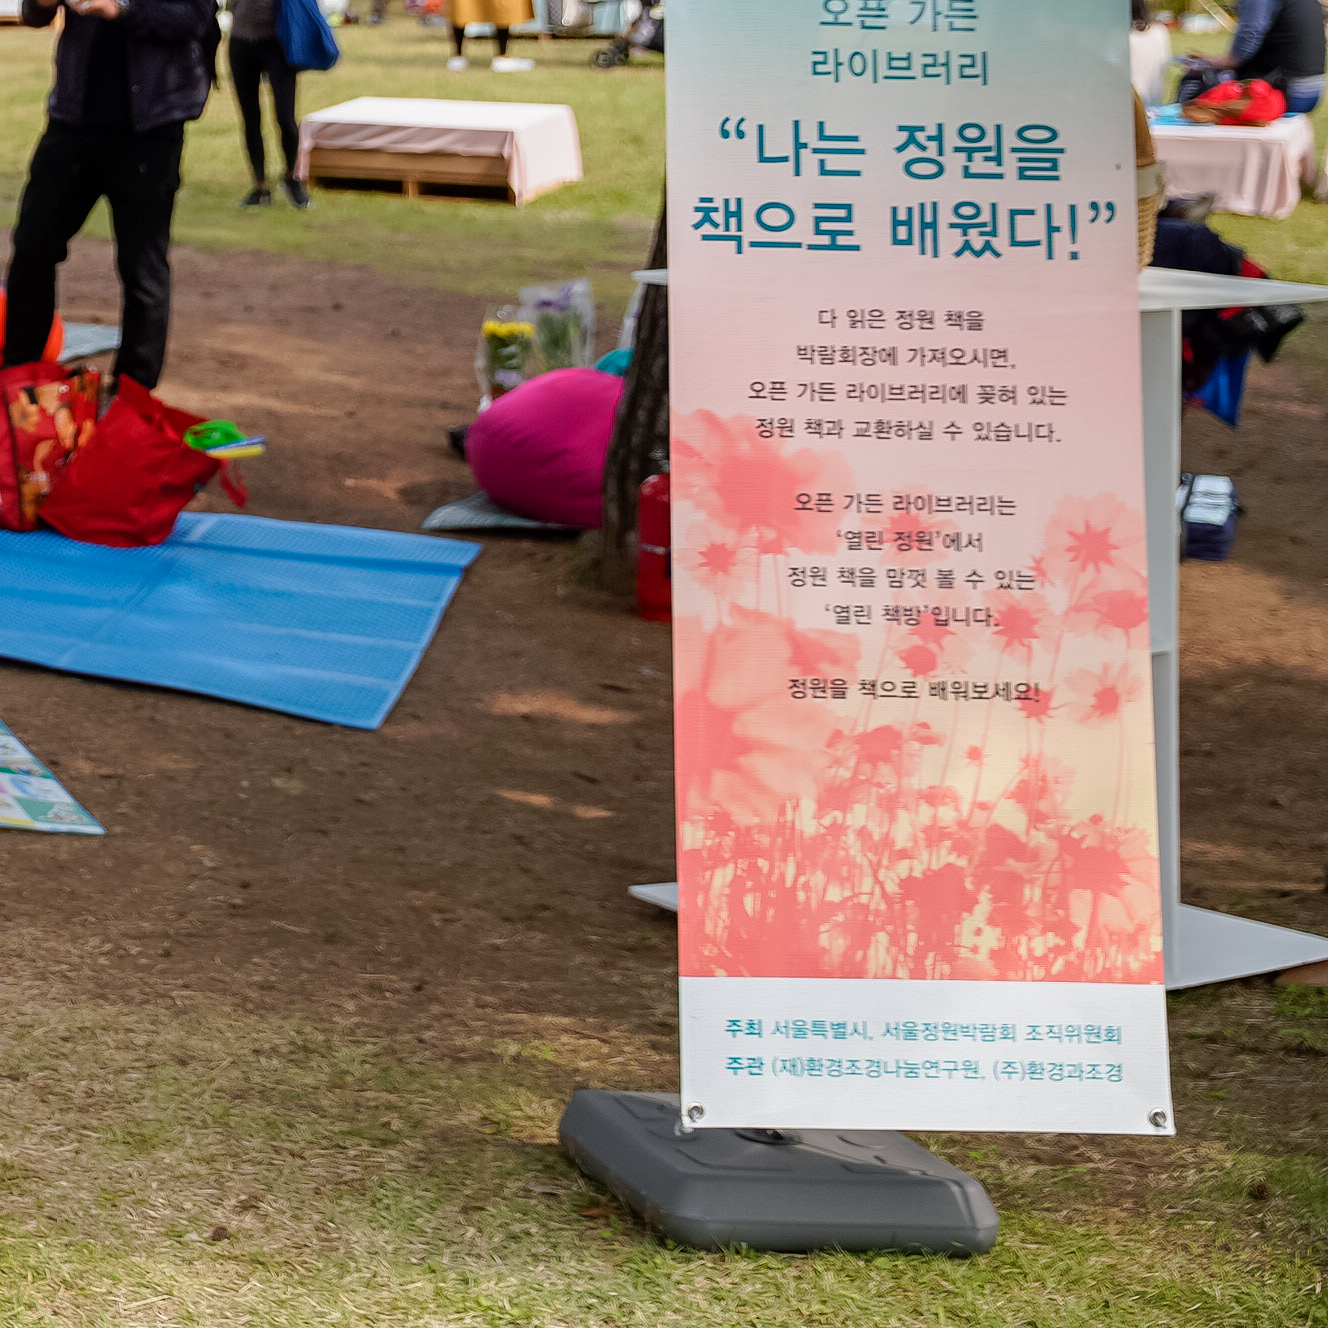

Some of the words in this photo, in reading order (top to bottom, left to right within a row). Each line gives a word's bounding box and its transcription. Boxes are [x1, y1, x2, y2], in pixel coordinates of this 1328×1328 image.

[811, 48, 989, 86] 라이브러리
[719, 116, 866, 177] “나는
[895, 122, 1066, 182] 정원을
[692, 196, 860, 254] 책으로
[890, 201, 1116, 260] 배웠다!”
[818, 309, 837, 328] 다
[847, 308, 886, 329] 읽은
[895, 309, 935, 330] 정원
[944, 309, 985, 331] 책을
[797, 345, 898, 366] 박람회장에
[907, 347, 1016, 370] 가져오시면,
[748, 381, 787, 401] 오픈
[797, 382, 837, 402] 가든
[846, 383, 969, 404] 라이브러리에
[977, 385, 1017, 405] 꽂혀
[1027, 386, 1068, 406] 있는
[755, 418, 795, 439] 정원
[804, 419, 845, 440] 책과
[852, 419, 933, 440] 교환하실
[944, 421, 962, 441] 수
[973, 421, 1062, 442] 있습니다.
[794, 493, 834, 512] 오픈
[843, 494, 883, 513] 가든
[893, 494, 1017, 516] 라이브러리는
[789, 567, 827, 587] 정원
[837, 567, 876, 587] 책을
[886, 568, 926, 588] 맘껏
[936, 569, 955, 589] 볼
[965, 569, 985, 590] 수
[994, 570, 1035, 590] 있는
[789, 678, 848, 699] 정원을
[858, 679, 919, 699] 책으로
[929, 681, 1039, 703] 배워보세요!
[726, 1018, 763, 1038] 주최
[771, 1018, 874, 1042] 서울특별시,
[882, 1022, 1017, 1043] 서울정원박람회
[1026, 1023, 1122, 1045] 조직위원회
[726, 1057, 763, 1076] 주관
[993, 1059, 1123, 1083] (주)환경과조경
